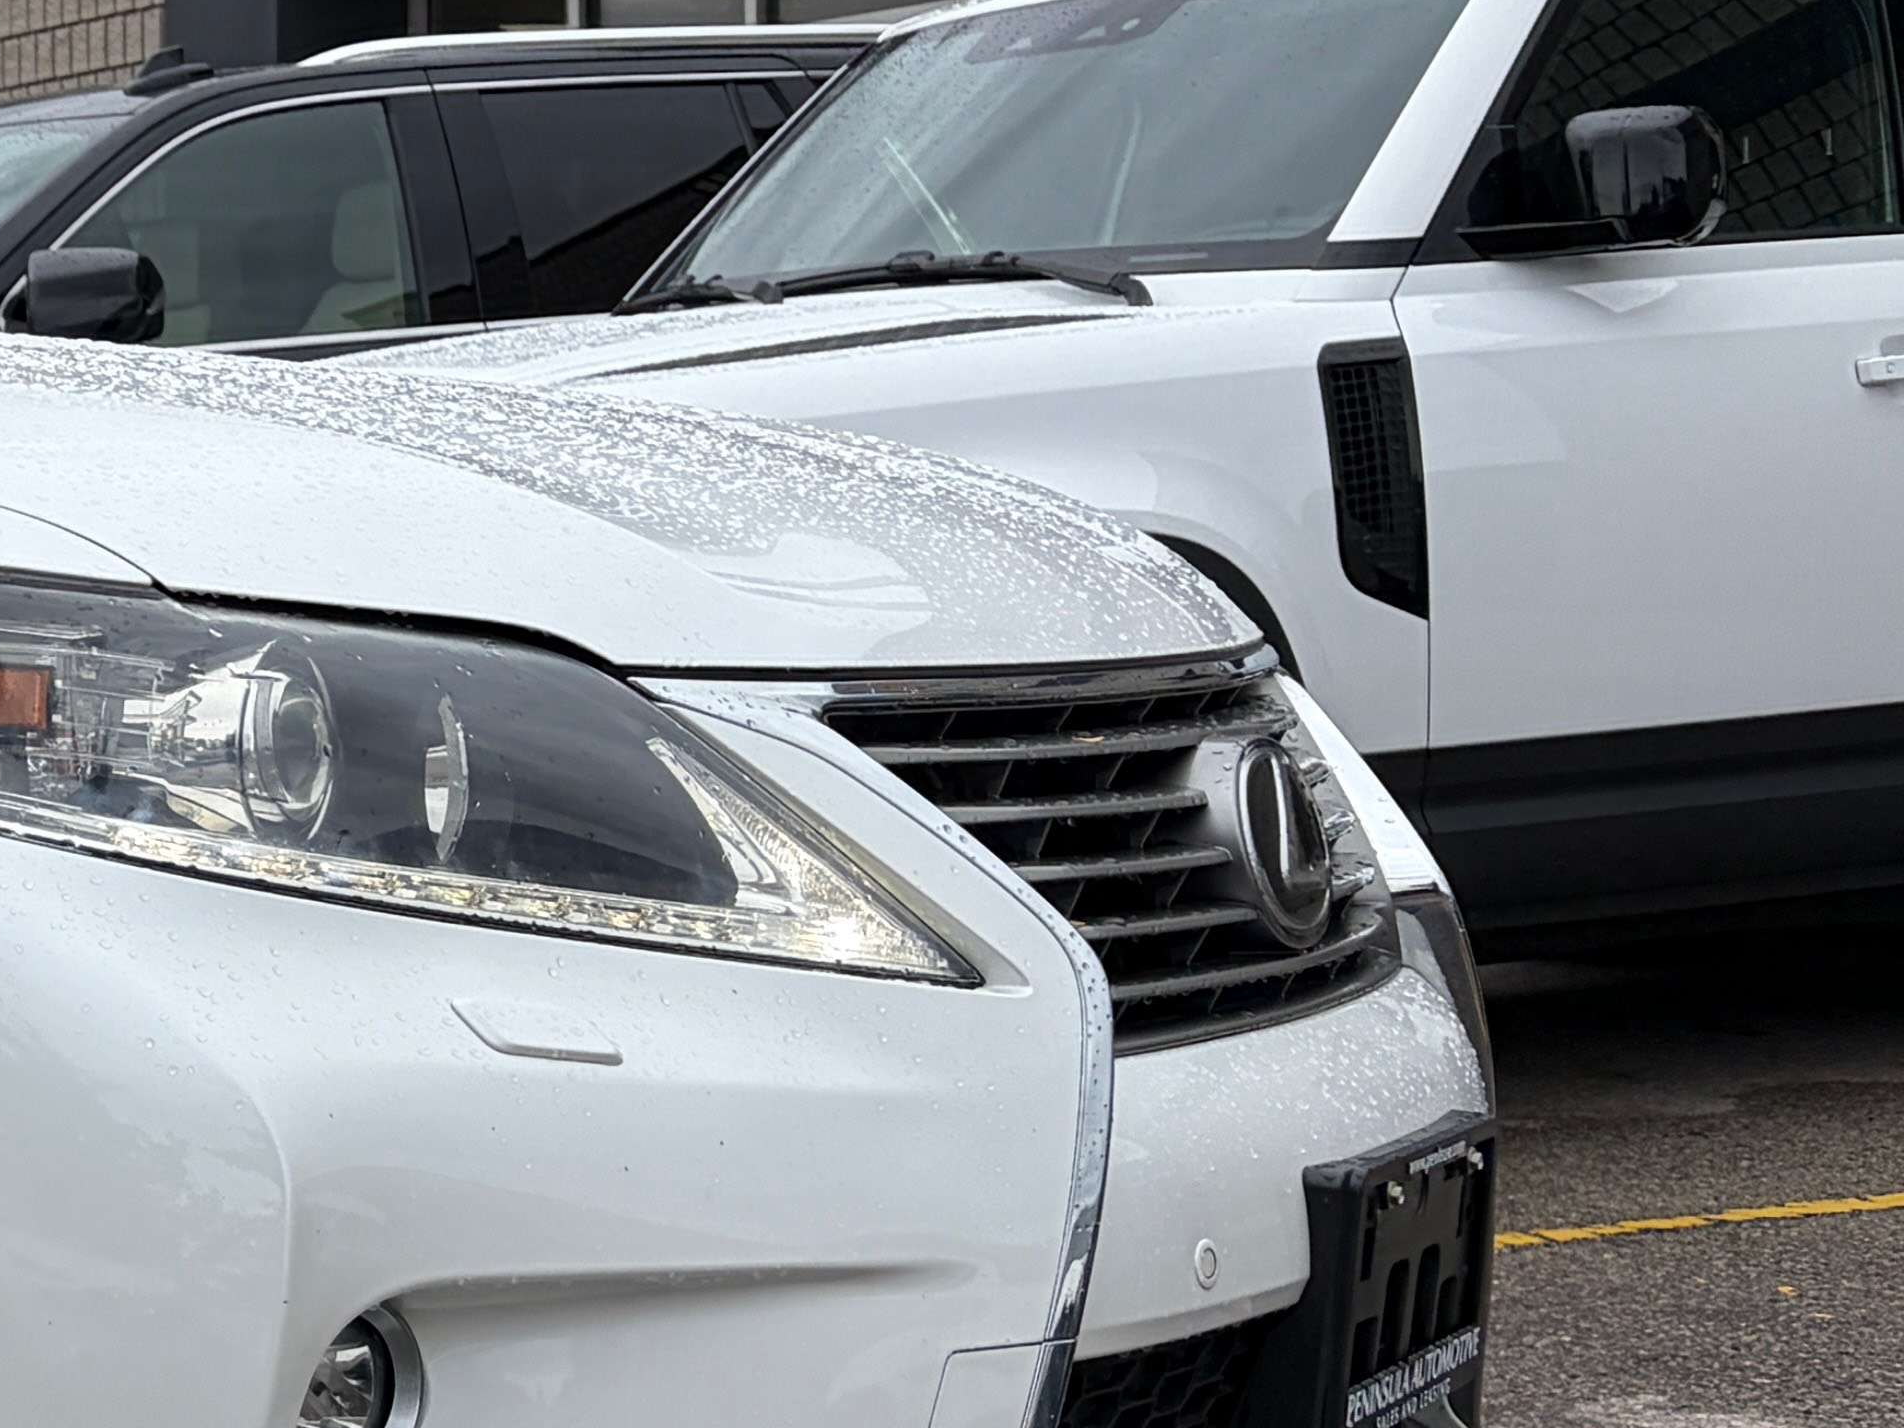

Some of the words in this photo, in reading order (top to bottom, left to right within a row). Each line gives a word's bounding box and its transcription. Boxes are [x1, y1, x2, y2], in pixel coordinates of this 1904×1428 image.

[1345, 1364, 1410, 1428] PENINSULA
[1410, 1326, 1481, 1392] AUTOMOTIVE
[1400, 1396, 1418, 1420] AND
[1419, 1377, 1452, 1410] LEASING
